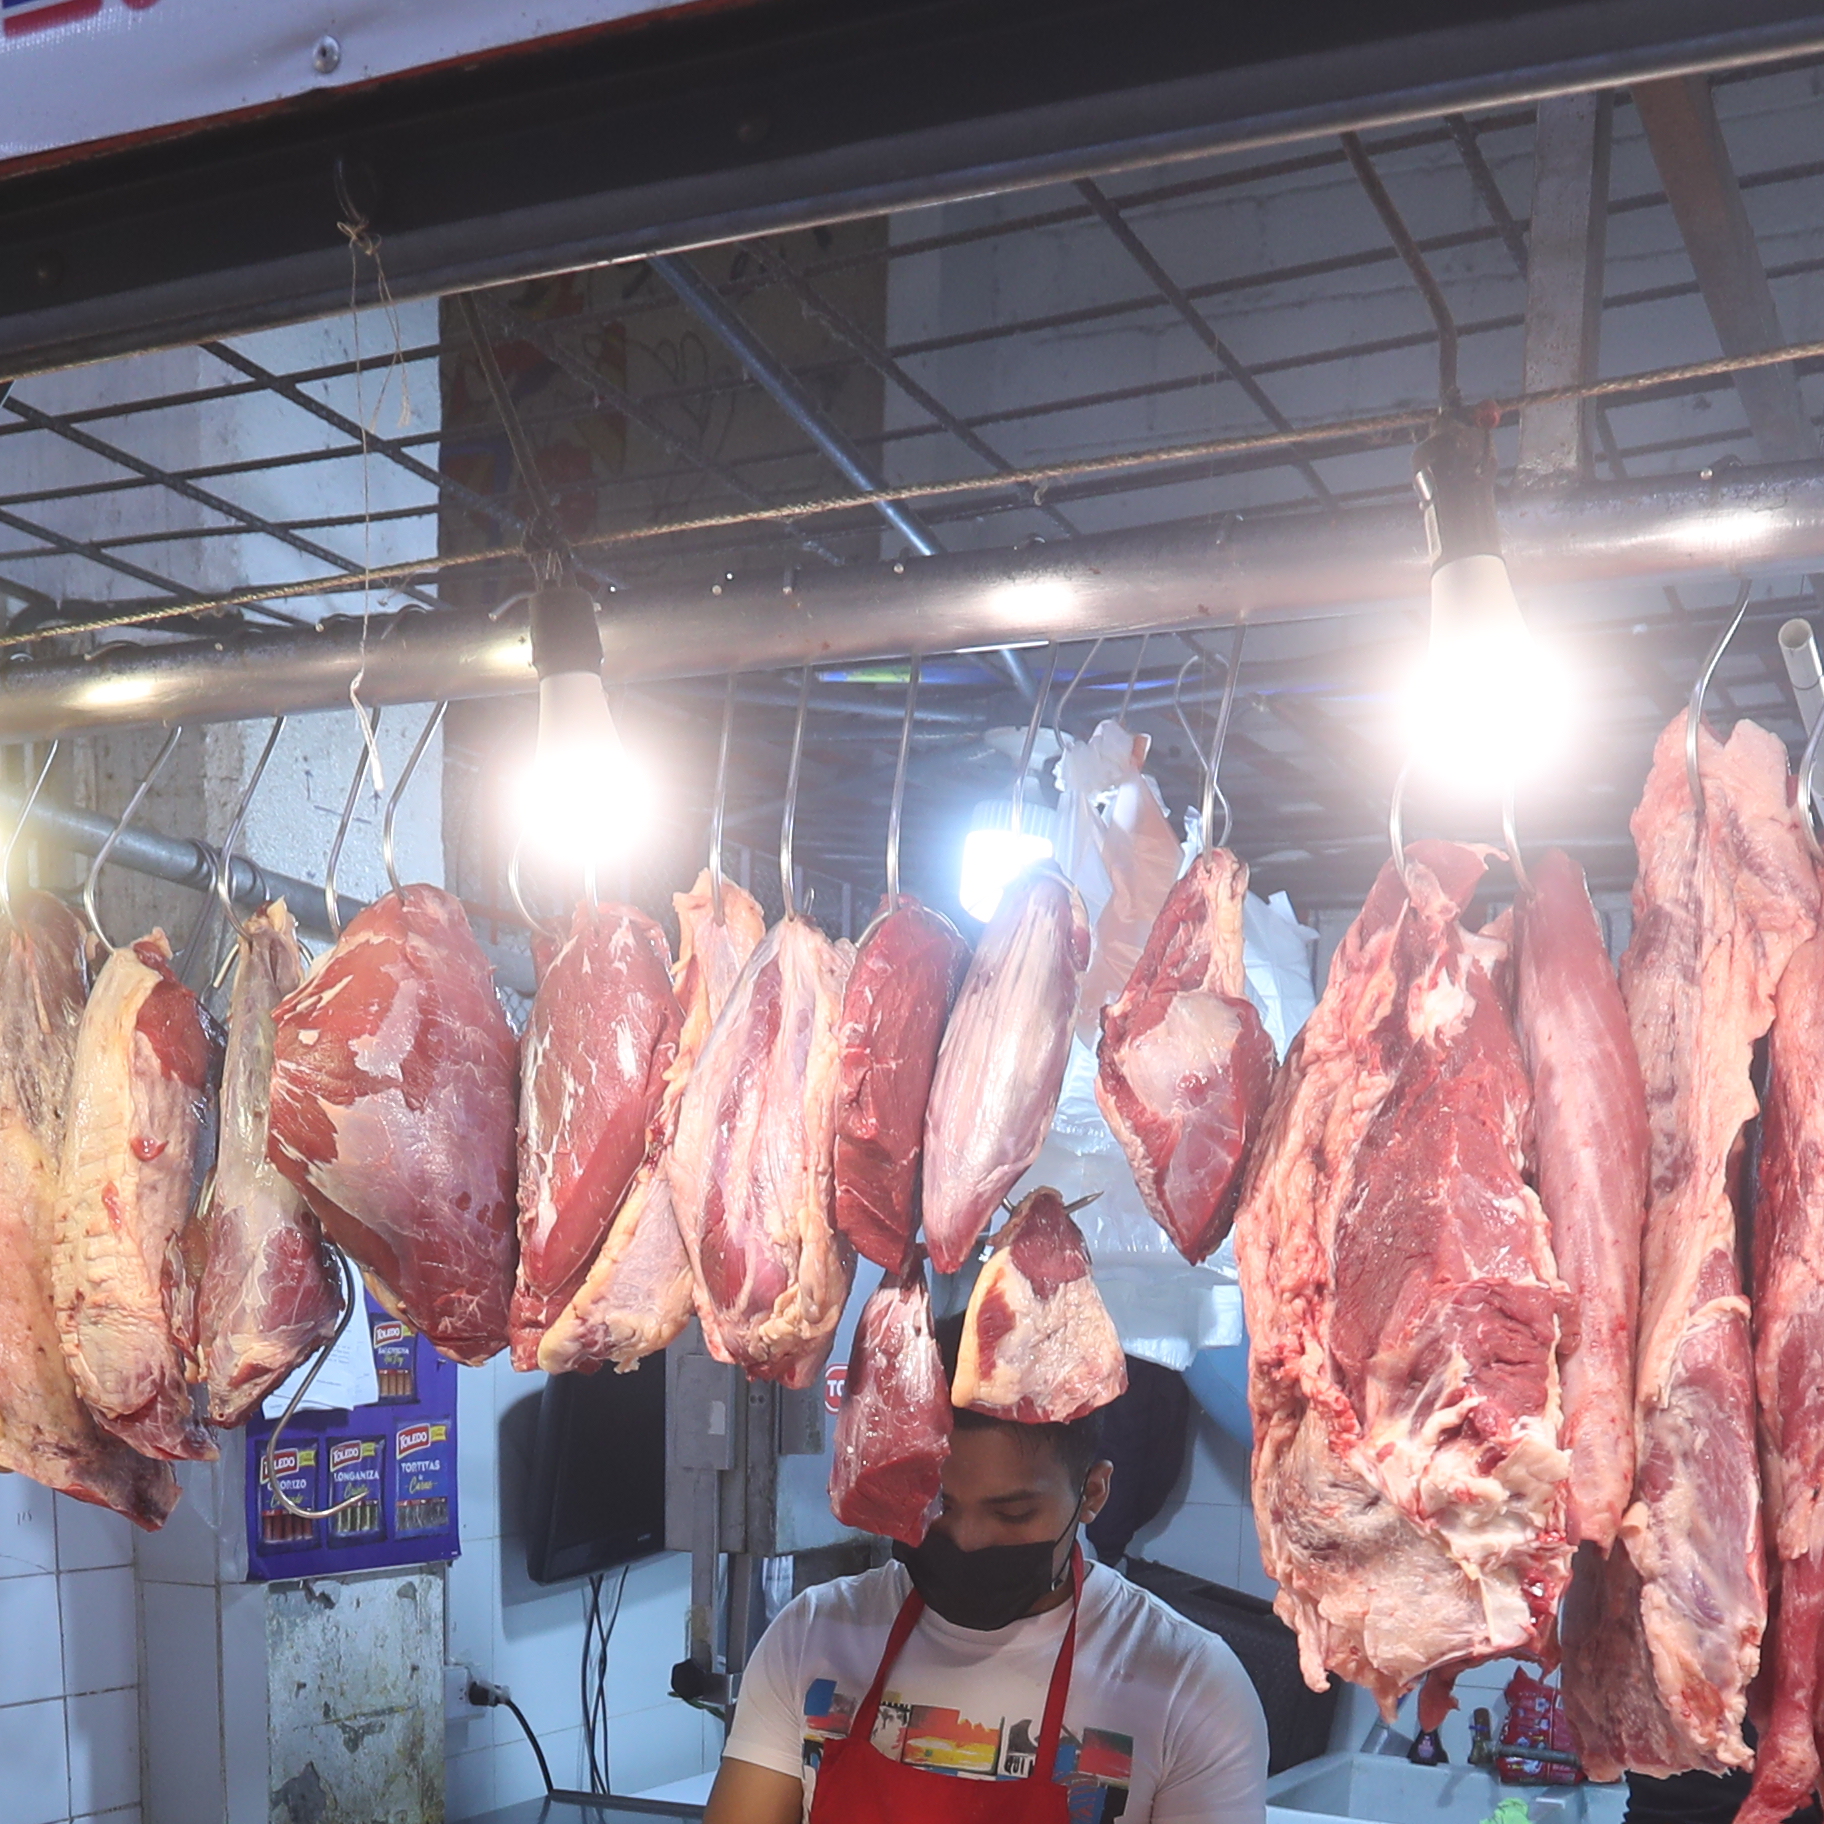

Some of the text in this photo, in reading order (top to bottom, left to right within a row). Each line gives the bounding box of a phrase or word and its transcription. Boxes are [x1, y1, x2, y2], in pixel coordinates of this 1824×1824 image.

[399, 1431, 428, 1450] TOLEDO
[333, 1447, 359, 1464] TOLEDO
[263, 1456, 295, 1476] TLEDO
[400, 1459, 441, 1473] TORTITAS
[333, 1469, 381, 1482] LONGANIZA
[267, 1478, 307, 1491] CORIZO
